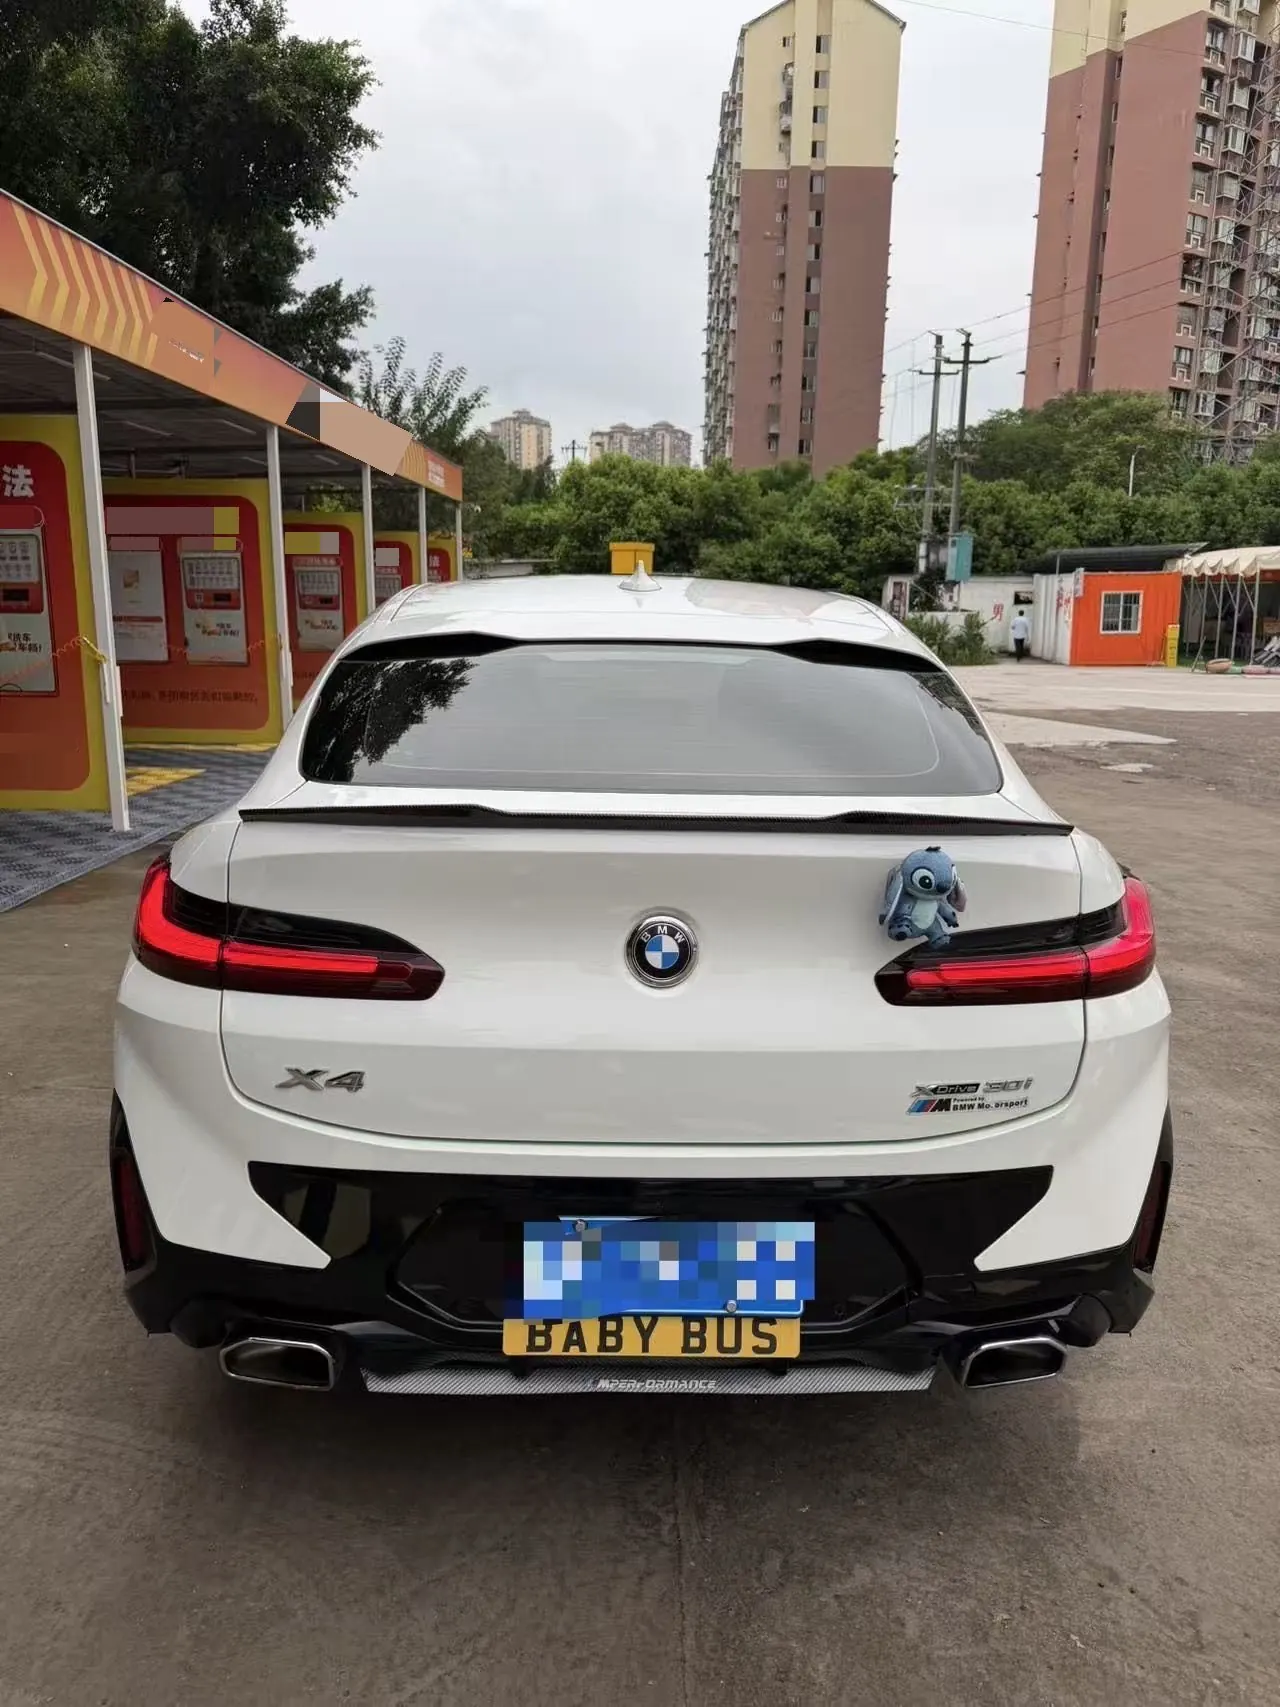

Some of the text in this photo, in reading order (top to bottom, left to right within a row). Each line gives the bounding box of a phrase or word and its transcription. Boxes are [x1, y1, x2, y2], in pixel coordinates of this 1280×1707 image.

[2, 464, 35, 498] 法
[641, 926, 686, 943] BMW
[275, 1066, 367, 1093] X4
[952, 1098, 1028, 1112] BMW Moorsport
[525, 1317, 778, 1355] BABY BUS
